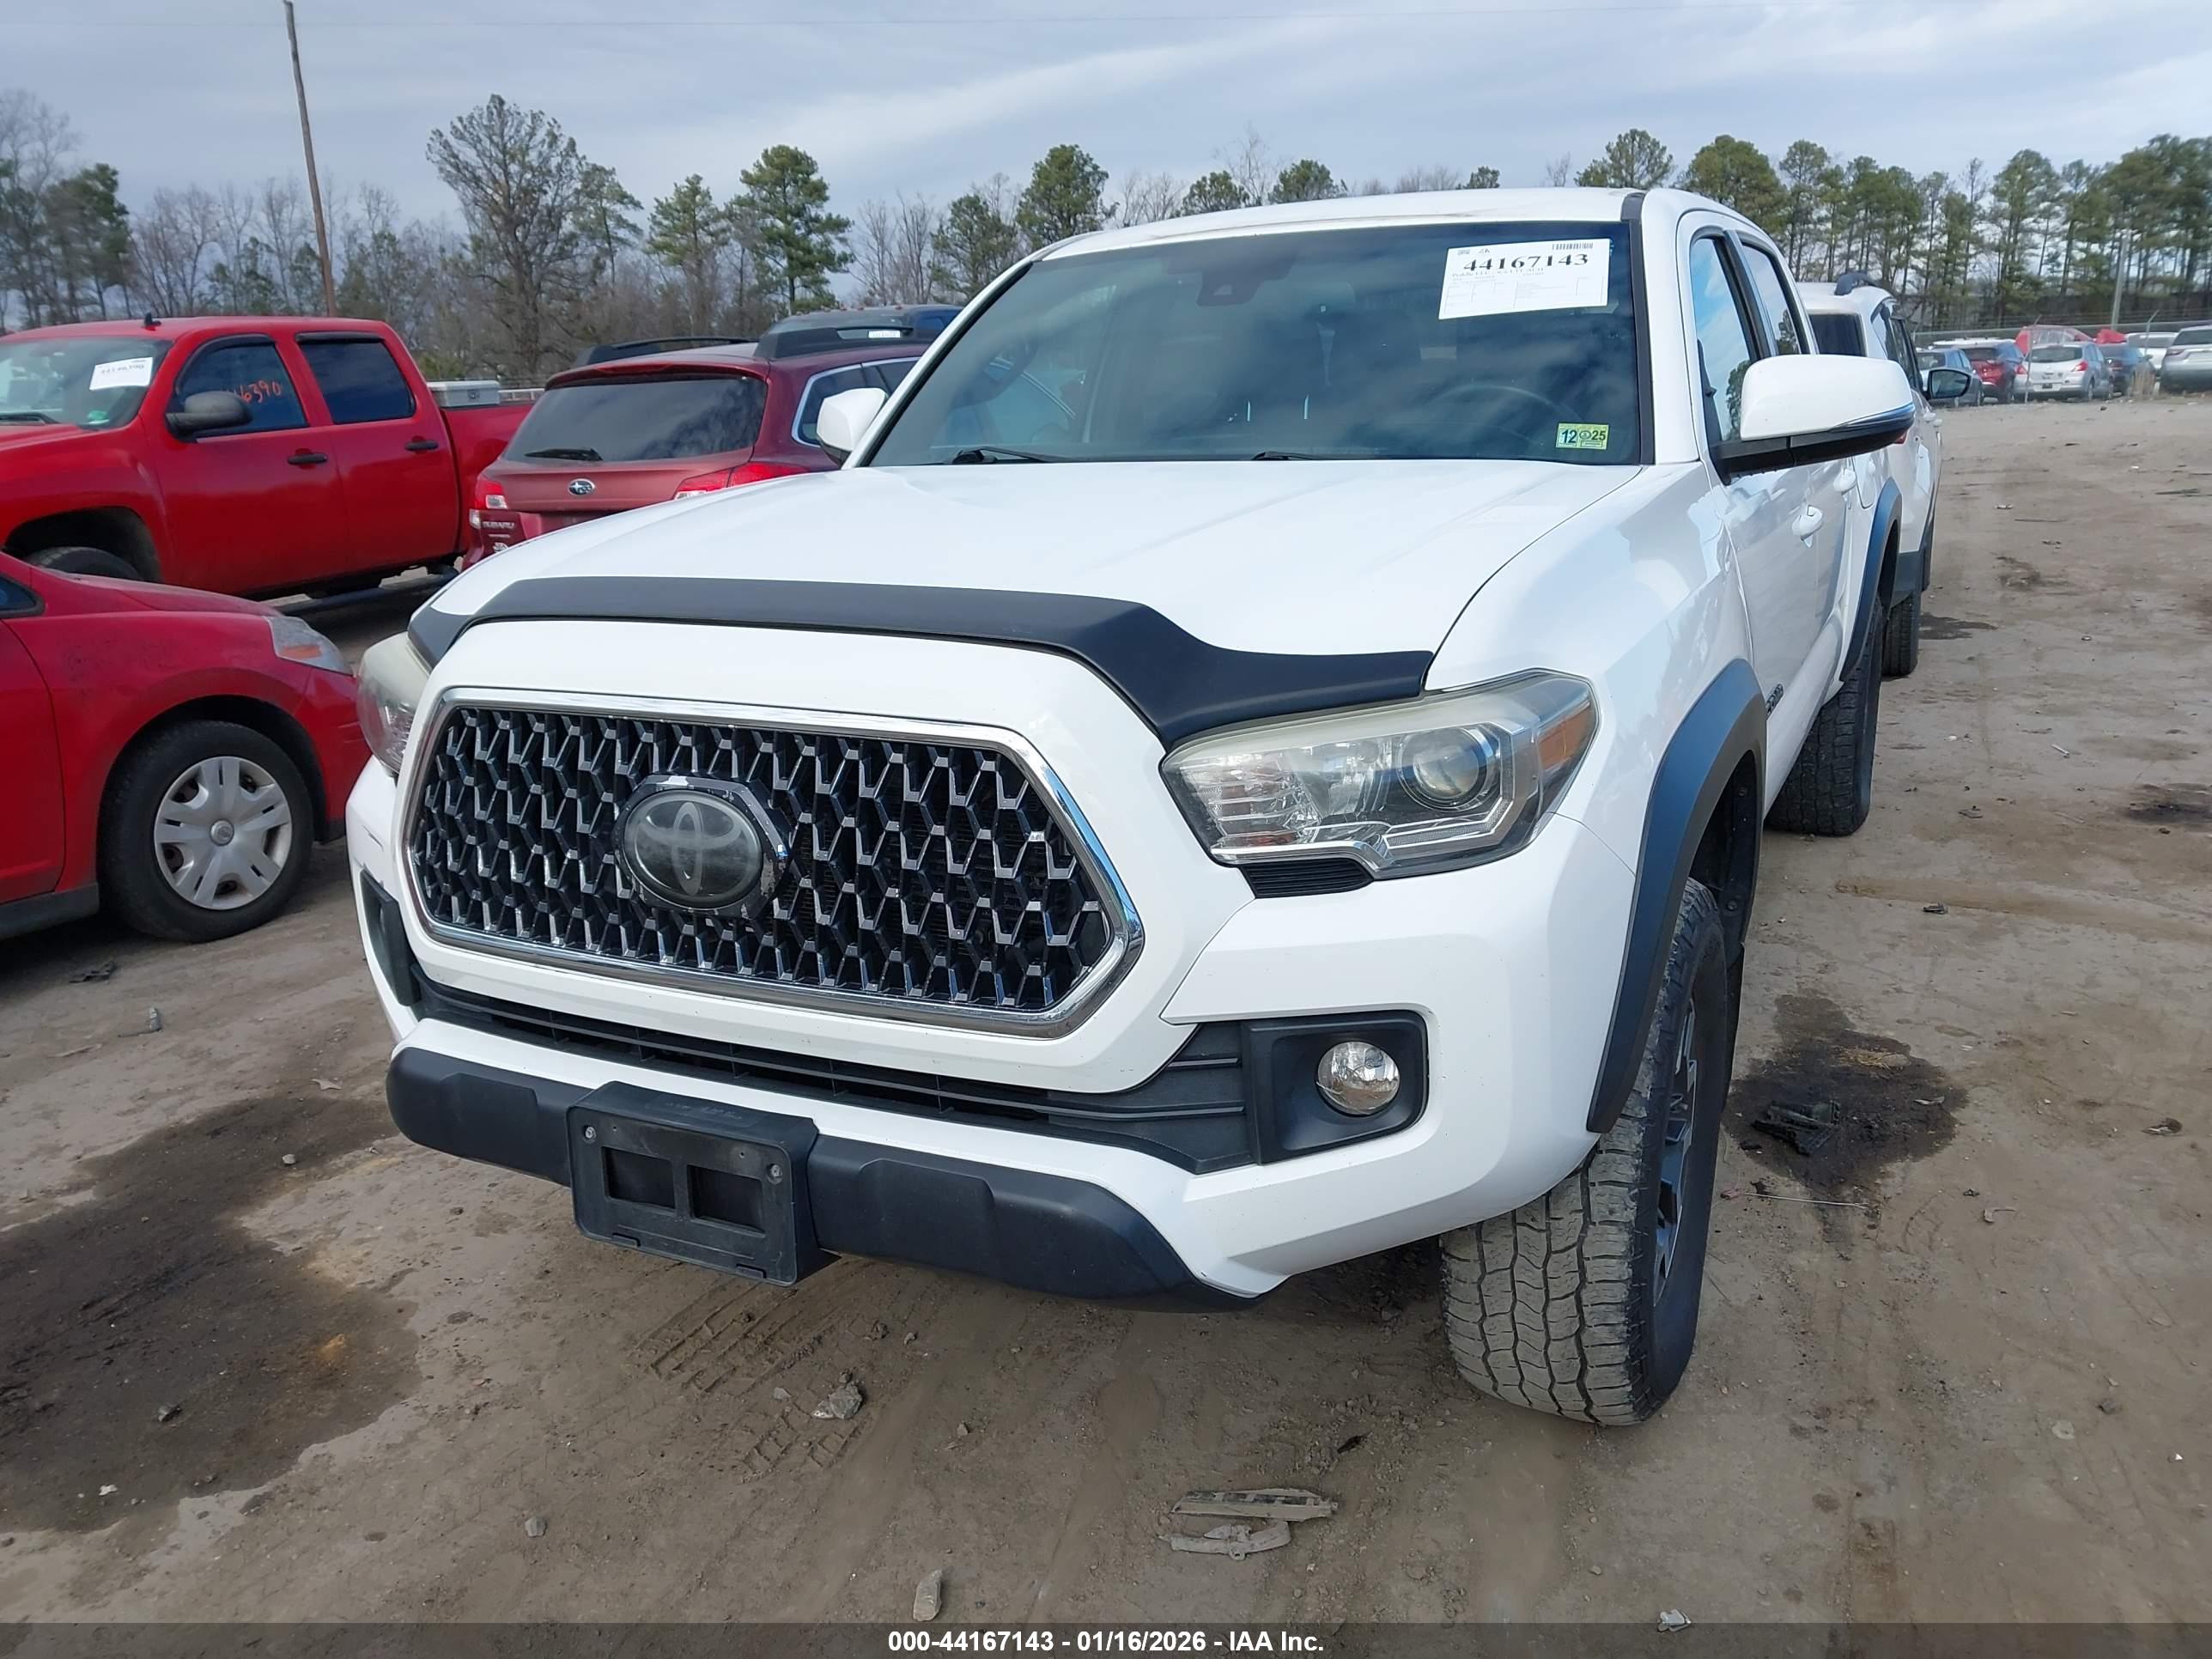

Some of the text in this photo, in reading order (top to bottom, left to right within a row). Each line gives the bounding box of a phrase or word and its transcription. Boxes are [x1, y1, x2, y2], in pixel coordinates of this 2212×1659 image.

[1463, 253, 1589, 271] 44167143
[227, 380, 282, 403] 6390
[1561, 429, 1606, 443] 12 25
